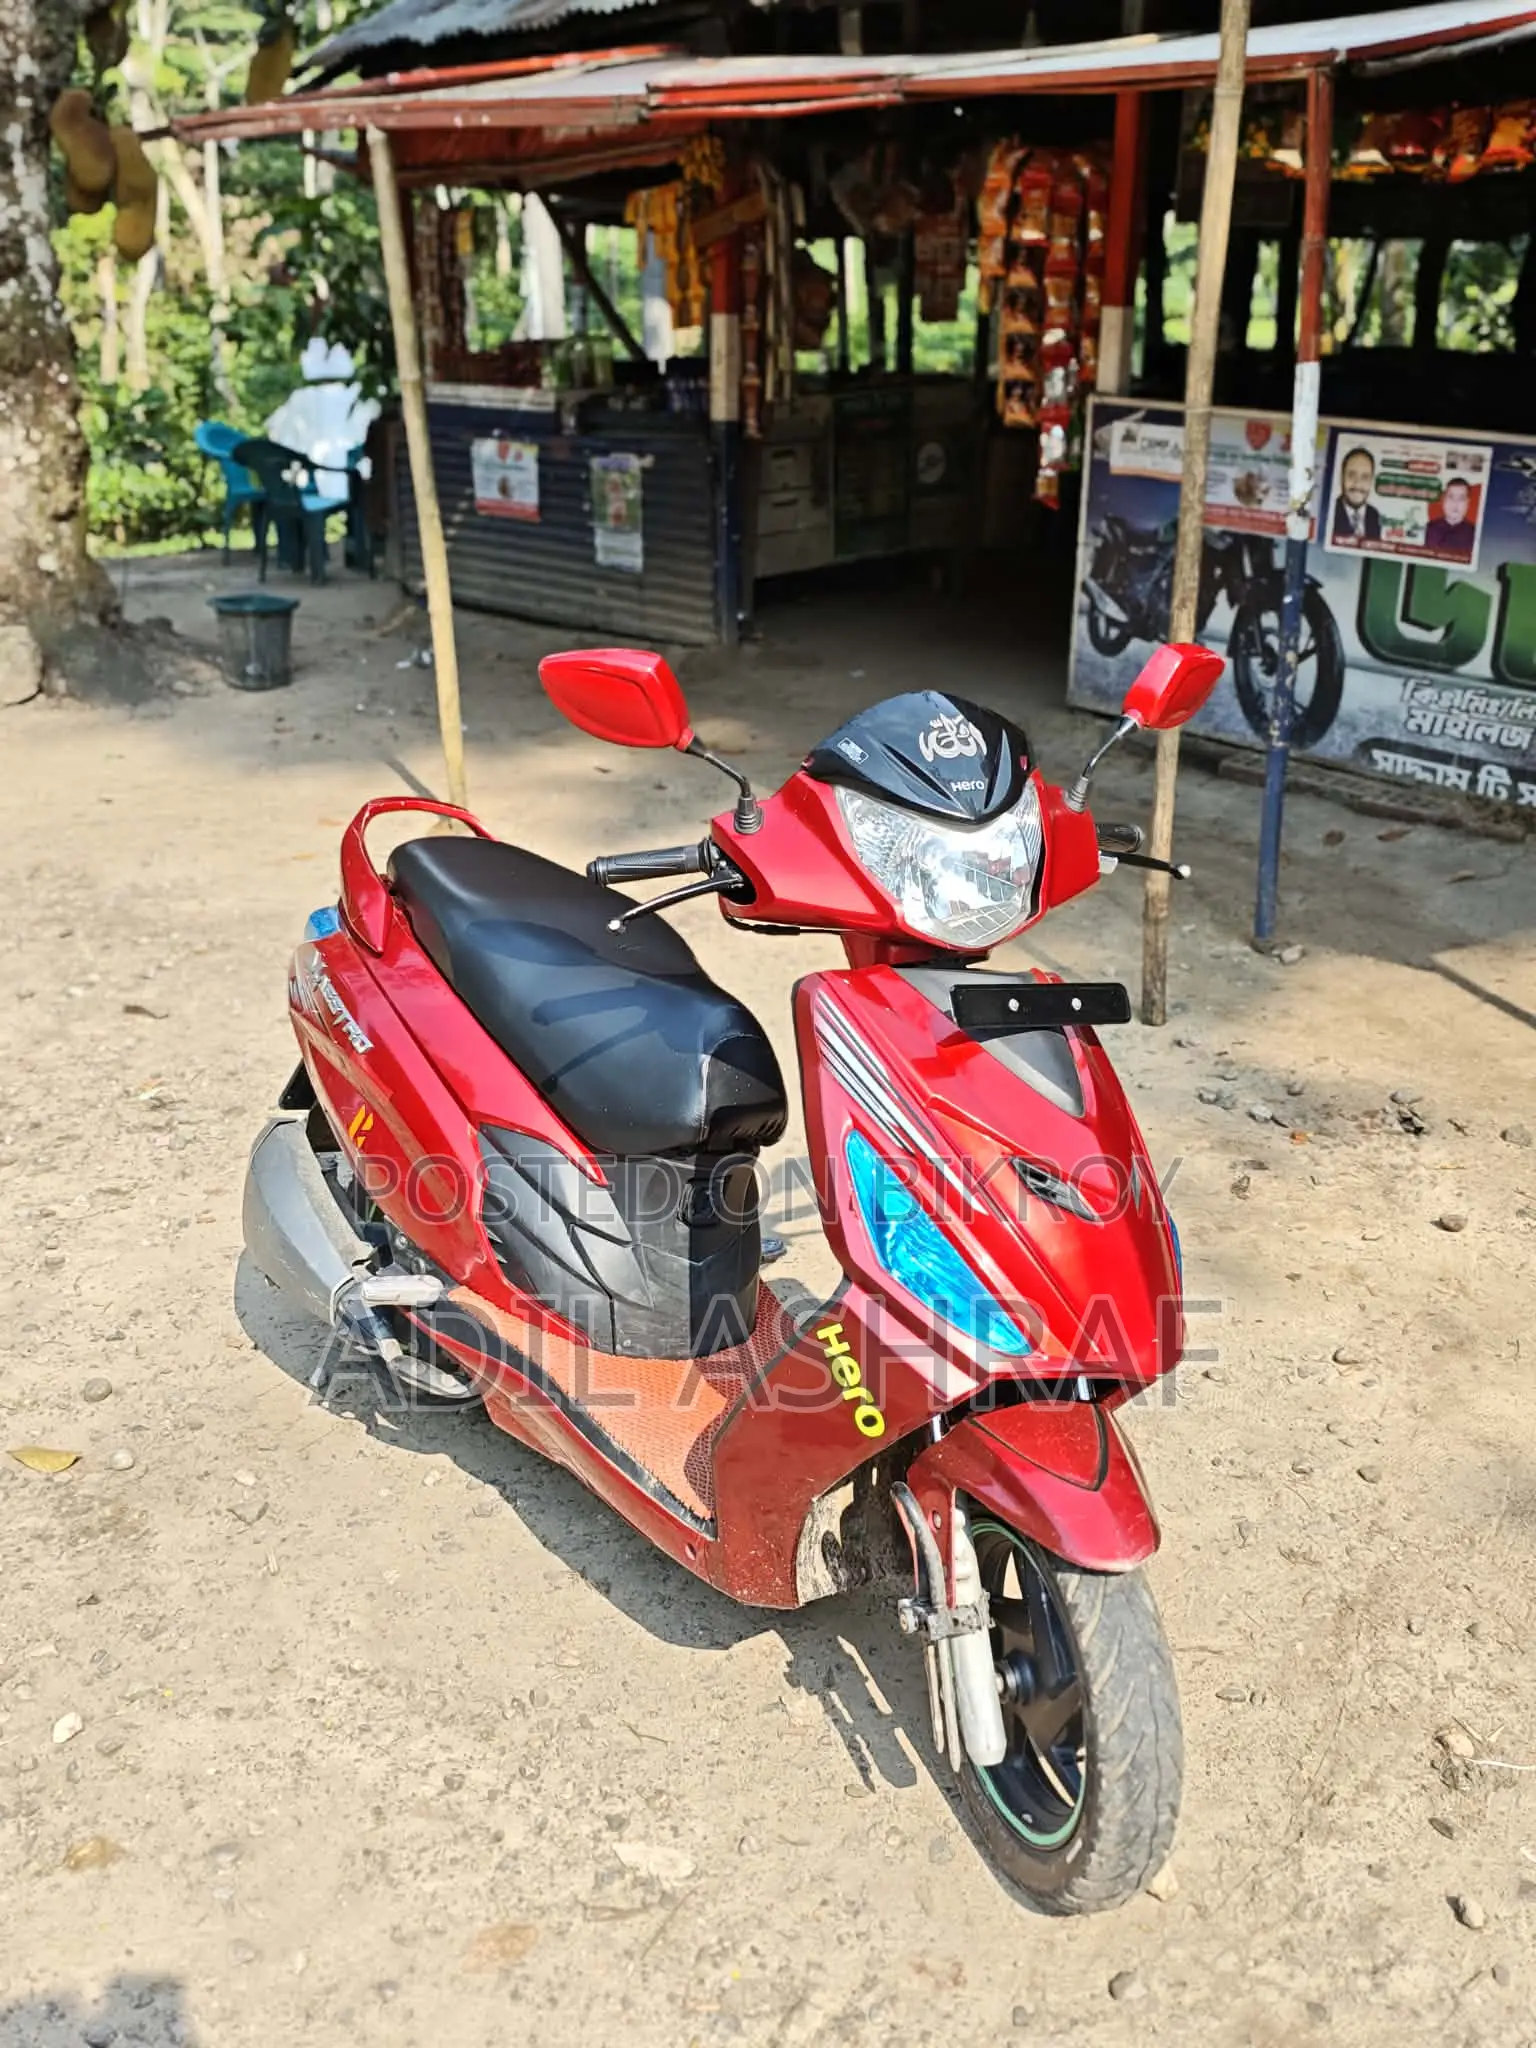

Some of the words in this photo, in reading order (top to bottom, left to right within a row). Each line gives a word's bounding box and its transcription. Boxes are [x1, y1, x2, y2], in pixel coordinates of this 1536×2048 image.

[951, 778, 985, 793] Hero
[1476, 764, 1513, 801] টি
[816, 1322, 886, 1438] Hero
